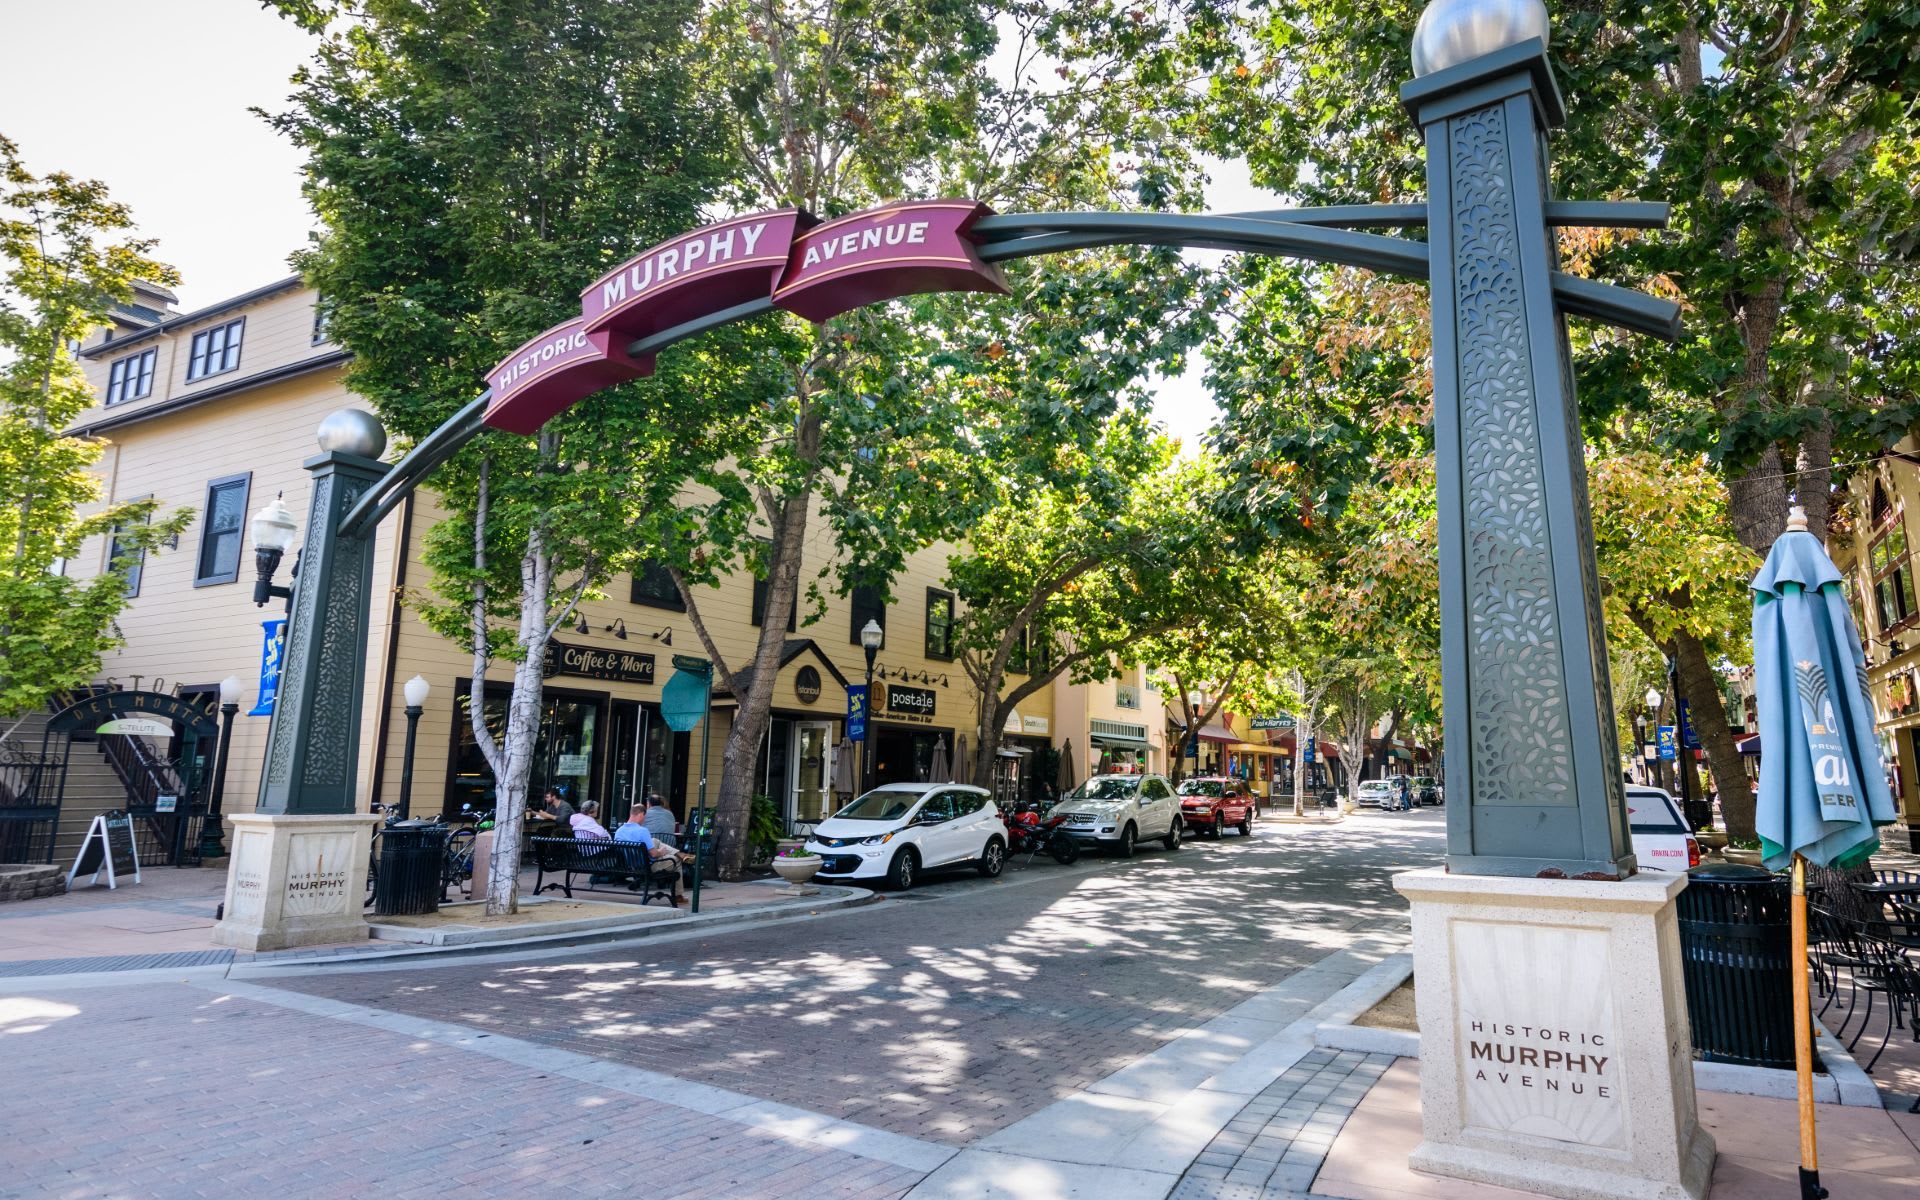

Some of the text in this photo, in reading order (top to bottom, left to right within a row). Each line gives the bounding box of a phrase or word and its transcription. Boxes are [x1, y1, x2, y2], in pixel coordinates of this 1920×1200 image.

[499, 221, 929, 391] HISTORIC MURPHY AVENUE
[564, 648, 653, 674] Coffee & More
[595, 671, 626, 681] CAFE
[58, 674, 219, 717] HISTORIC
[891, 692, 933, 707] postale
[72, 695, 204, 726] DEL MONTE
[238, 880, 261, 890] MURPHY
[289, 880, 345, 891] MURPHY
[291, 871, 345, 879] HISTORIC
[289, 891, 343, 899] AVENUE
[1471, 1021, 1605, 1046] HISTORIC
[1470, 1040, 1609, 1075] MURPHY
[1475, 1069, 1610, 1098] AVENUE
